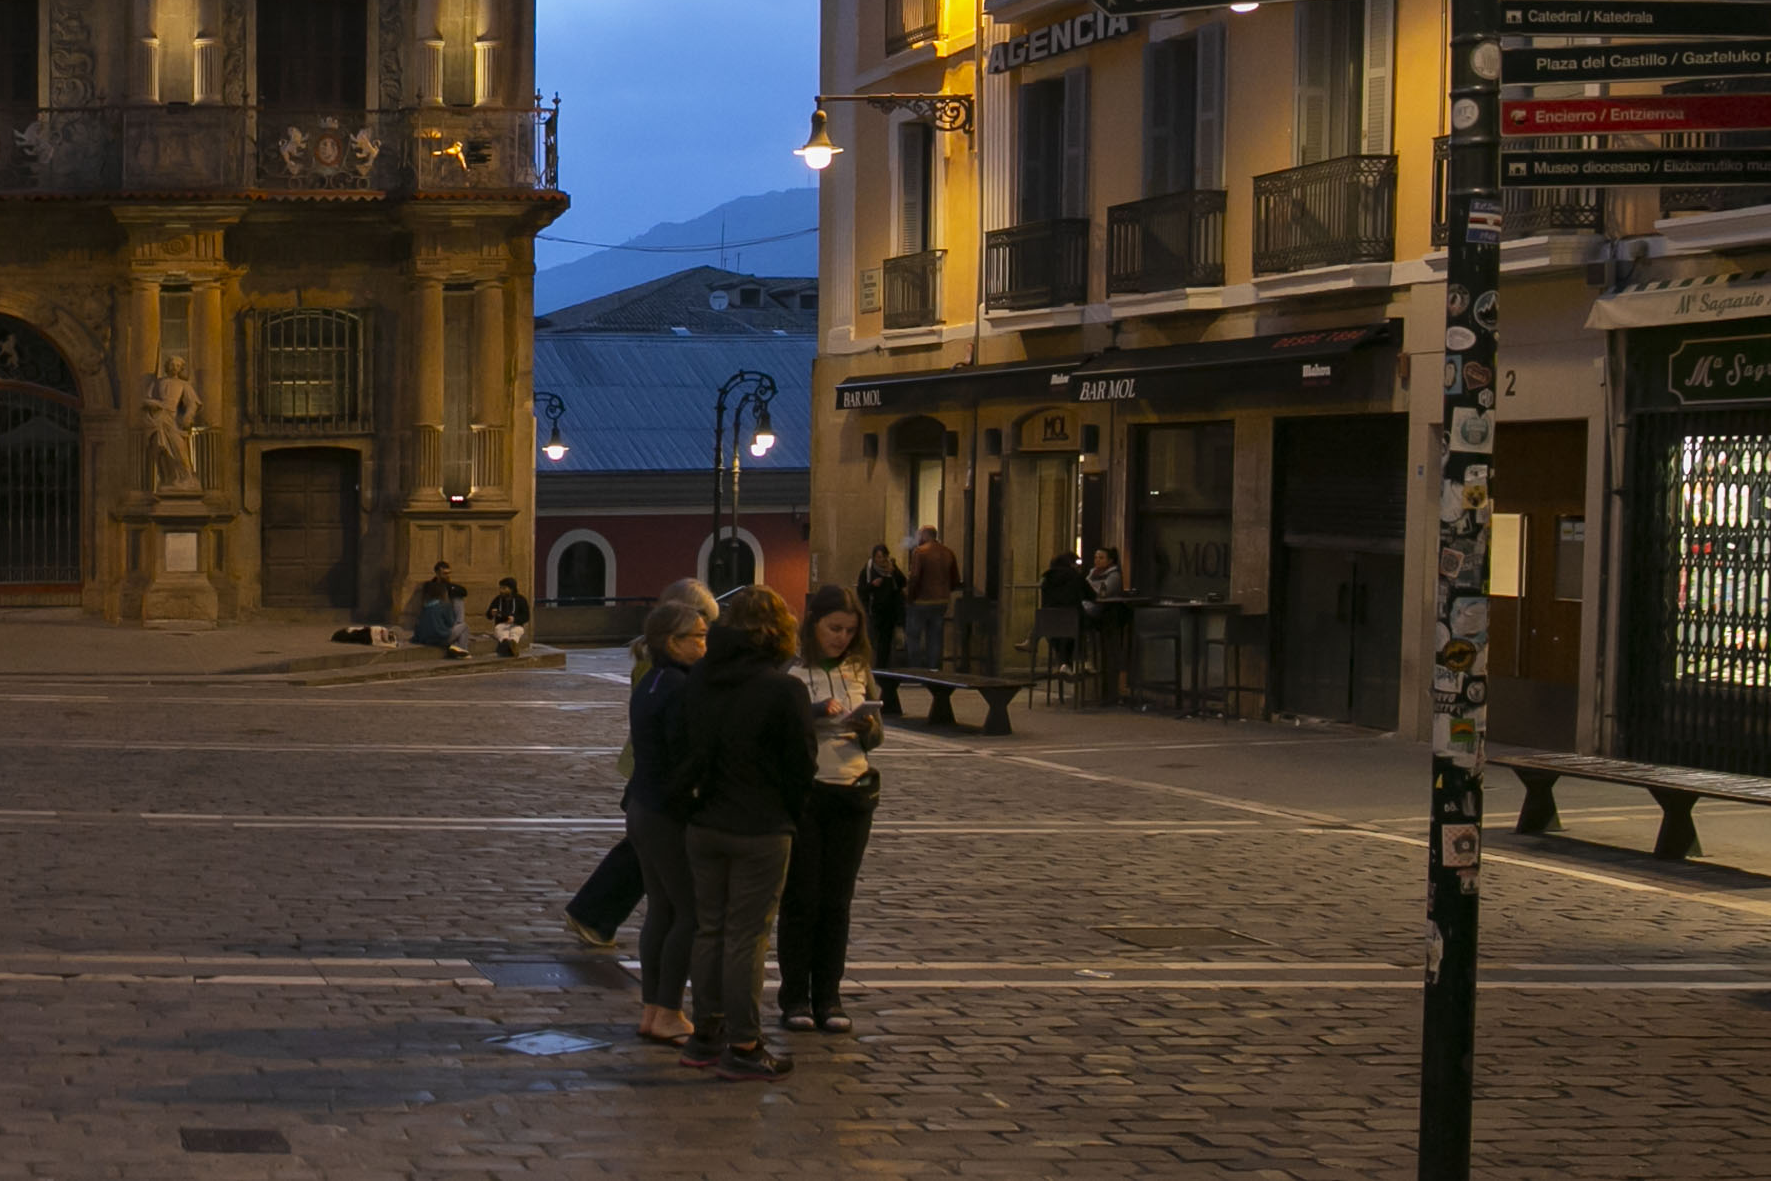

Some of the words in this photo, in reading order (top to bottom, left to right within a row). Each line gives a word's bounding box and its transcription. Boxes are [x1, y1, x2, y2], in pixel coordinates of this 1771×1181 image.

[1528, 9, 1582, 24] Catedral
[1594, 10, 1654, 25] Katedrala
[988, 13, 1131, 74] AGENCIA
[1536, 57, 1578, 71] Plaza
[1582, 55, 1606, 69] del
[1609, 52, 1668, 68] Castillo
[1682, 49, 1761, 66] Gazteluko
[1535, 109, 1597, 124] Encierro
[1610, 107, 1685, 122] Entzierroa
[1533, 161, 1579, 175] Museo
[1582, 160, 1651, 174] diocesano
[1663, 158, 1744, 173] Elizbarrutiko
[1080, 381, 1106, 402] BAR
[1107, 378, 1136, 399] MOL
[1505, 370, 1516, 396] 2
[843, 391, 861, 408] BAR
[862, 390, 882, 406] MOL
[1043, 416, 1068, 436] MOL
